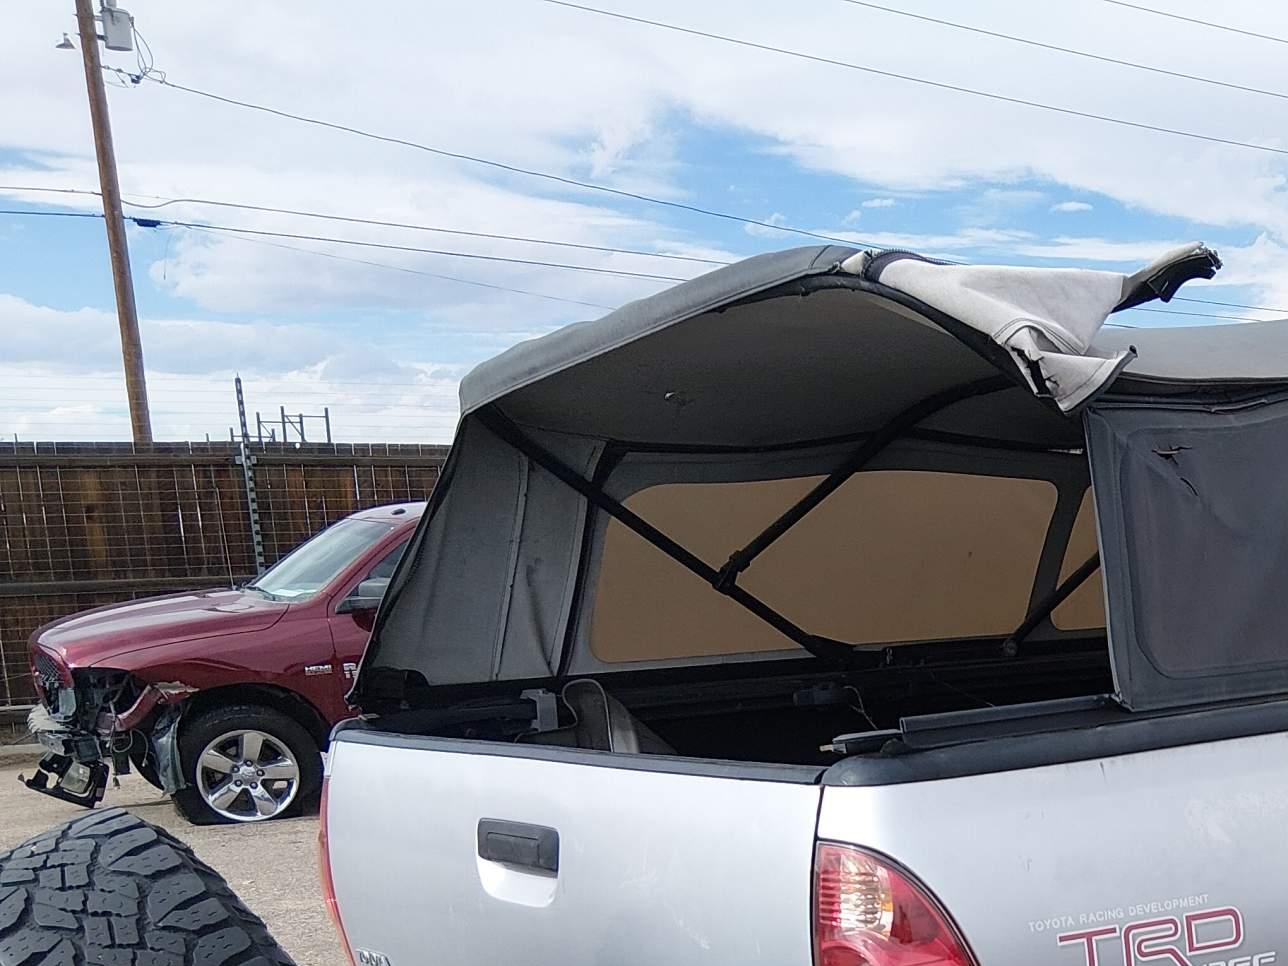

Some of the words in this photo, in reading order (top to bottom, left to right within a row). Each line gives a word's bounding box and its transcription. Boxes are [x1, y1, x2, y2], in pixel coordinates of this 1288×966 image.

[1028, 915, 1075, 933] TOYOTA
[1079, 906, 1124, 926] RACING
[1128, 893, 1209, 918] DEVELOPMENT
